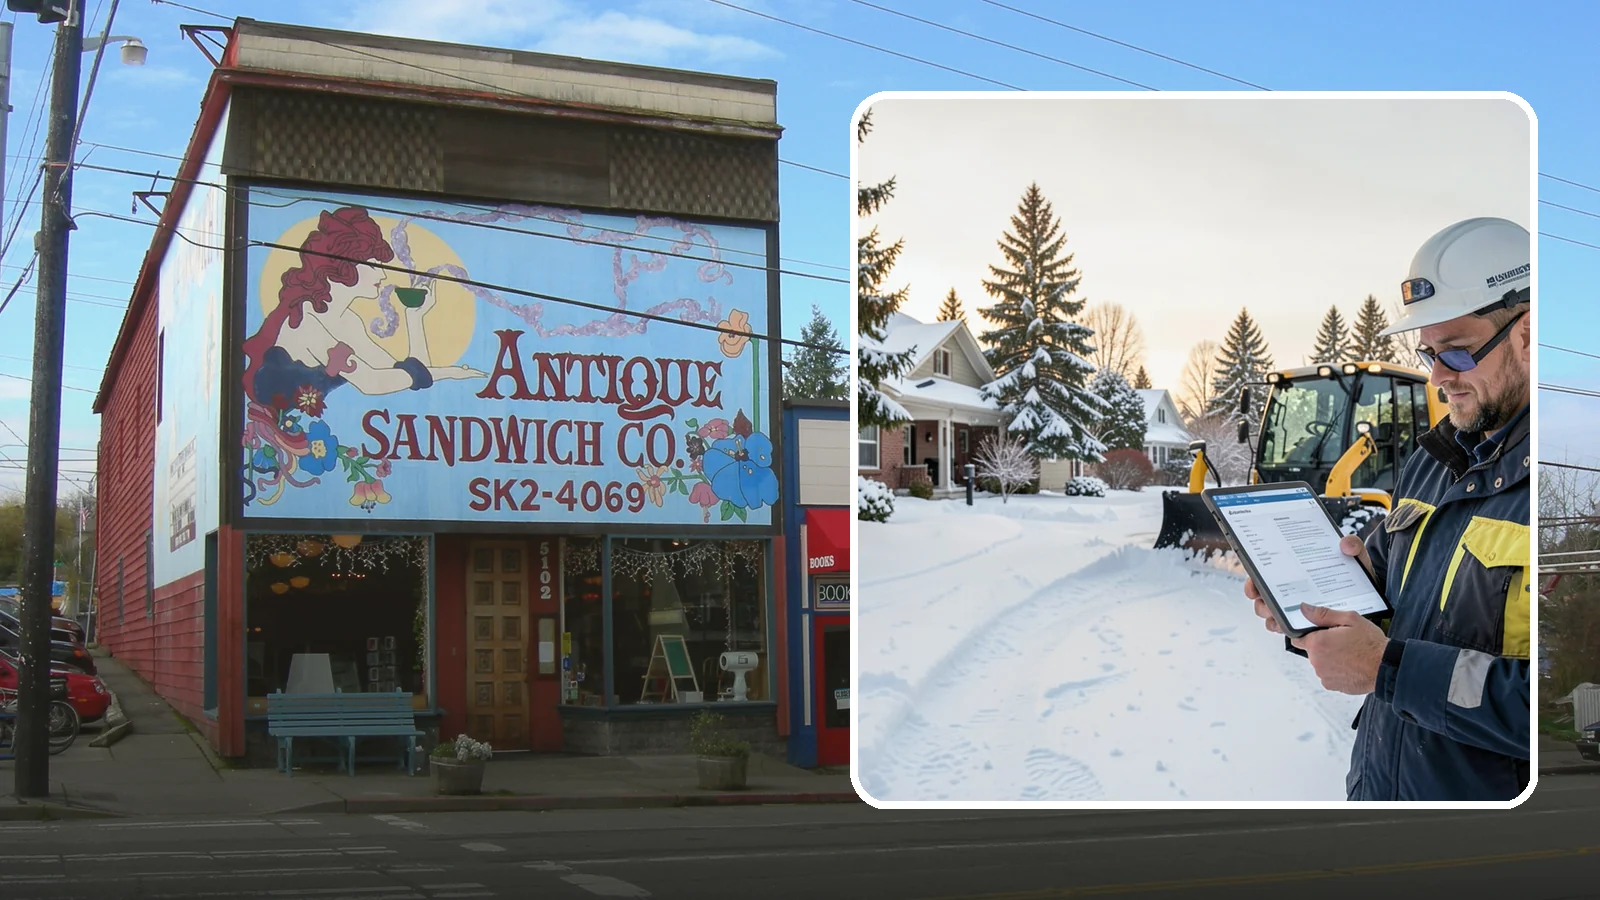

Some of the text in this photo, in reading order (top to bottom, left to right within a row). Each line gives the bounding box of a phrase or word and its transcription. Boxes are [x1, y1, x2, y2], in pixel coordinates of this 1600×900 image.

[477, 330, 723, 420] ANTIQUE
[361, 409, 684, 468] SANDWICH CO.
[468, 476, 646, 513] SK2-4069
[540, 542, 551, 599] 5102
[809, 555, 835, 569] BOOKS
